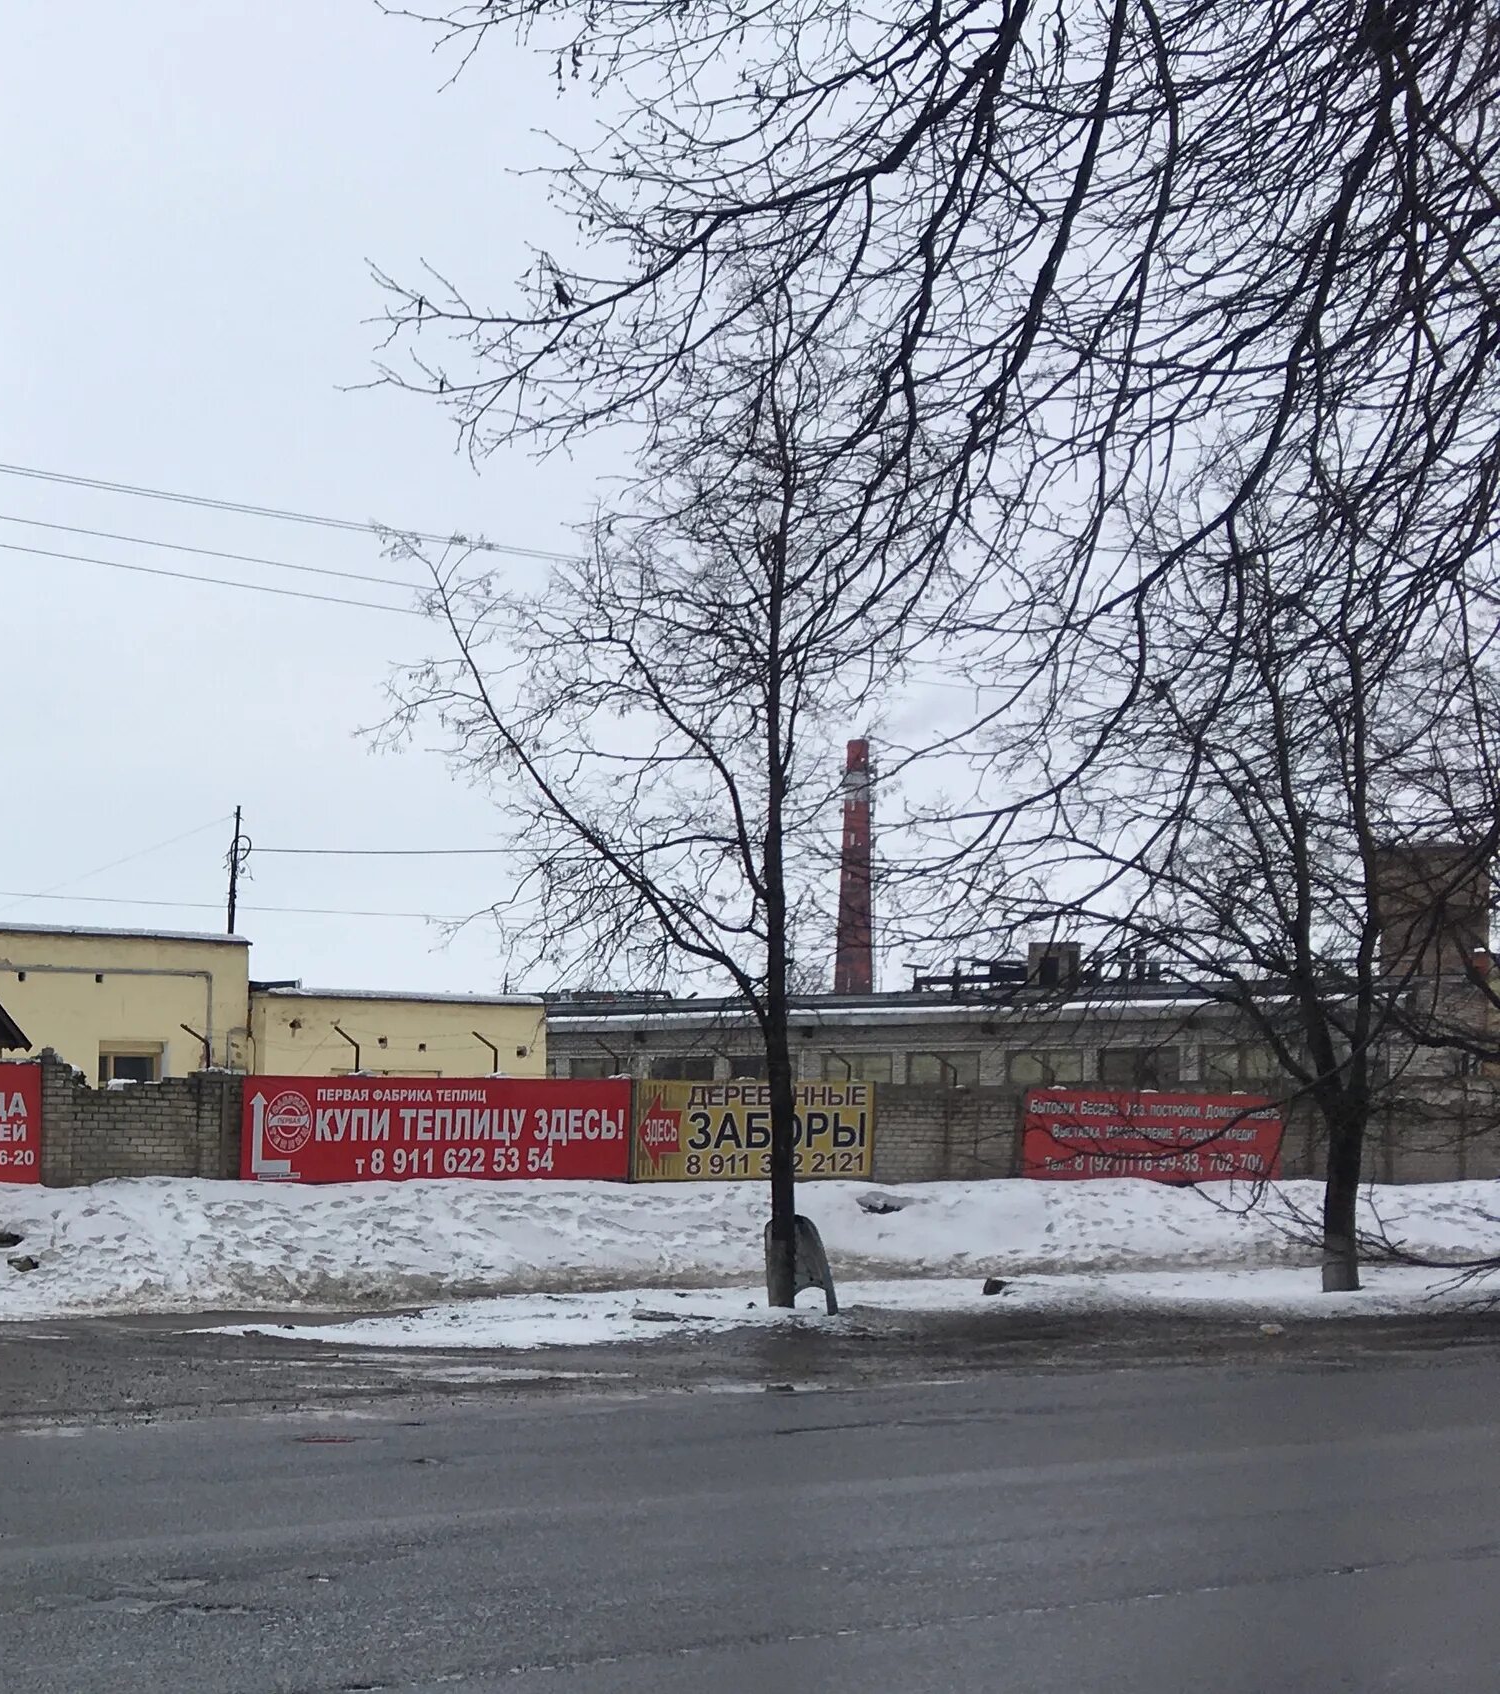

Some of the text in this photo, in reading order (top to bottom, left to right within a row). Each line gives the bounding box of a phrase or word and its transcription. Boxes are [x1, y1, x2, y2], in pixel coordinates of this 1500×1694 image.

[316, 1088, 487, 1104] ПЕРВАЯ ФАБРИКА ТЕПЛИЦ
[687, 1085, 867, 1110] ДЕРЕВННЫЕ
[314, 1108, 625, 1147] КУПИ ТЕПЛИЦУ ЗДЕСЬ!
[644, 1118, 678, 1146] ЗДЕСЬ
[370, 1148, 385, 1174] 8
[392, 1148, 434, 1174] 911
[443, 1147, 485, 1173] 622
[492, 1147, 520, 1172] 53
[527, 1147, 554, 1172] 54
[685, 1151, 864, 1176] 8 911 32 2121
